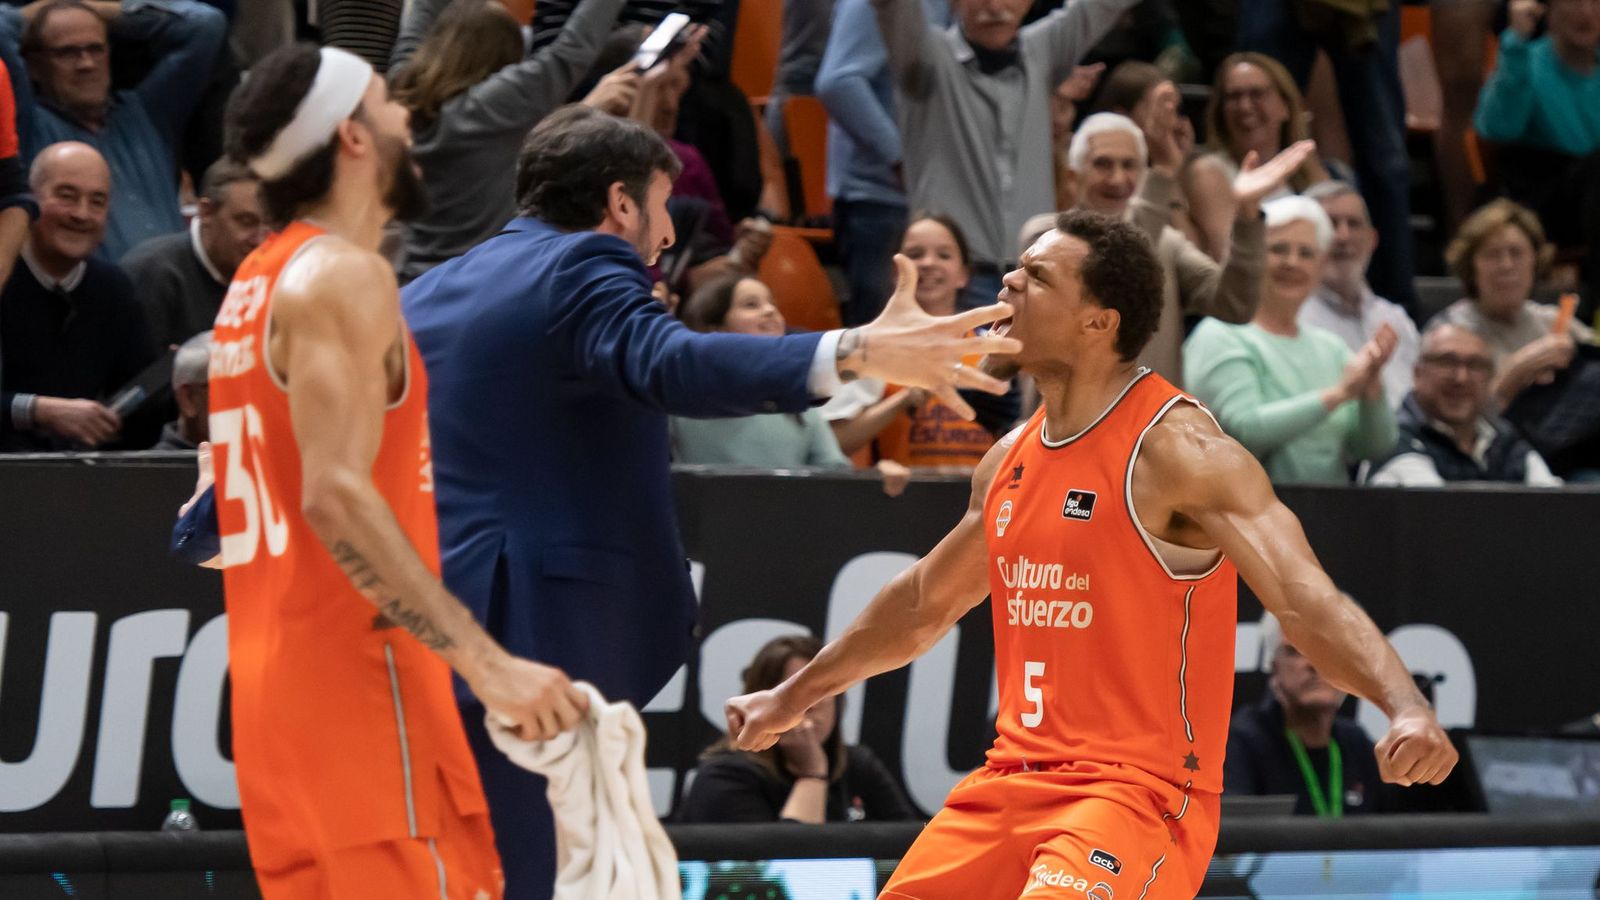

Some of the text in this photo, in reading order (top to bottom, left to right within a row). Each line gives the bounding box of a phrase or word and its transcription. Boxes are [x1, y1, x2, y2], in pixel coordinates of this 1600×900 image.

[1064, 507, 1090, 517] endesa
[997, 555, 1089, 591] Cultura del
[1006, 590, 1093, 629] sfuerzo
[1020, 661, 1046, 728] 5
[1093, 855, 1115, 870] acb
